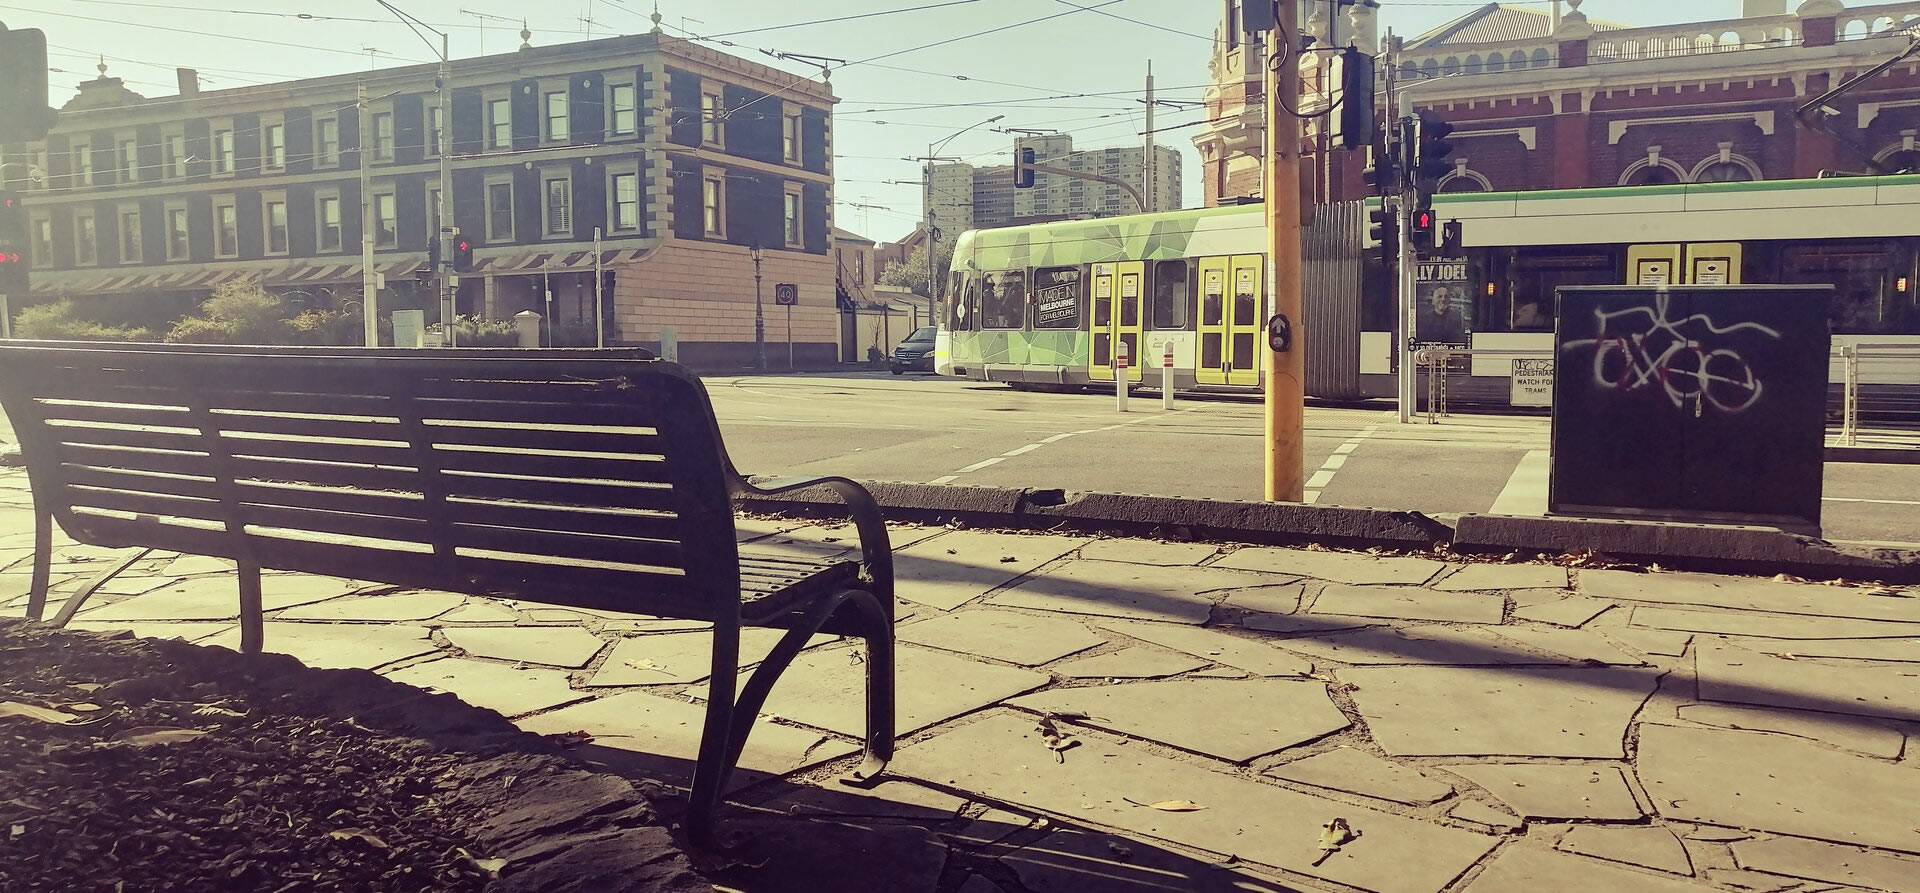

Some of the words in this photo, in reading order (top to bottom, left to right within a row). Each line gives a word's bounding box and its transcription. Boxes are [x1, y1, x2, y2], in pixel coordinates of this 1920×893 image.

[1416, 265, 1434, 280] LLY
[1437, 265, 1467, 280] JOEL
[780, 290, 791, 298] 40
[1040, 287, 1064, 303] MADE
[1040, 298, 1074, 312] MELBOURNE
